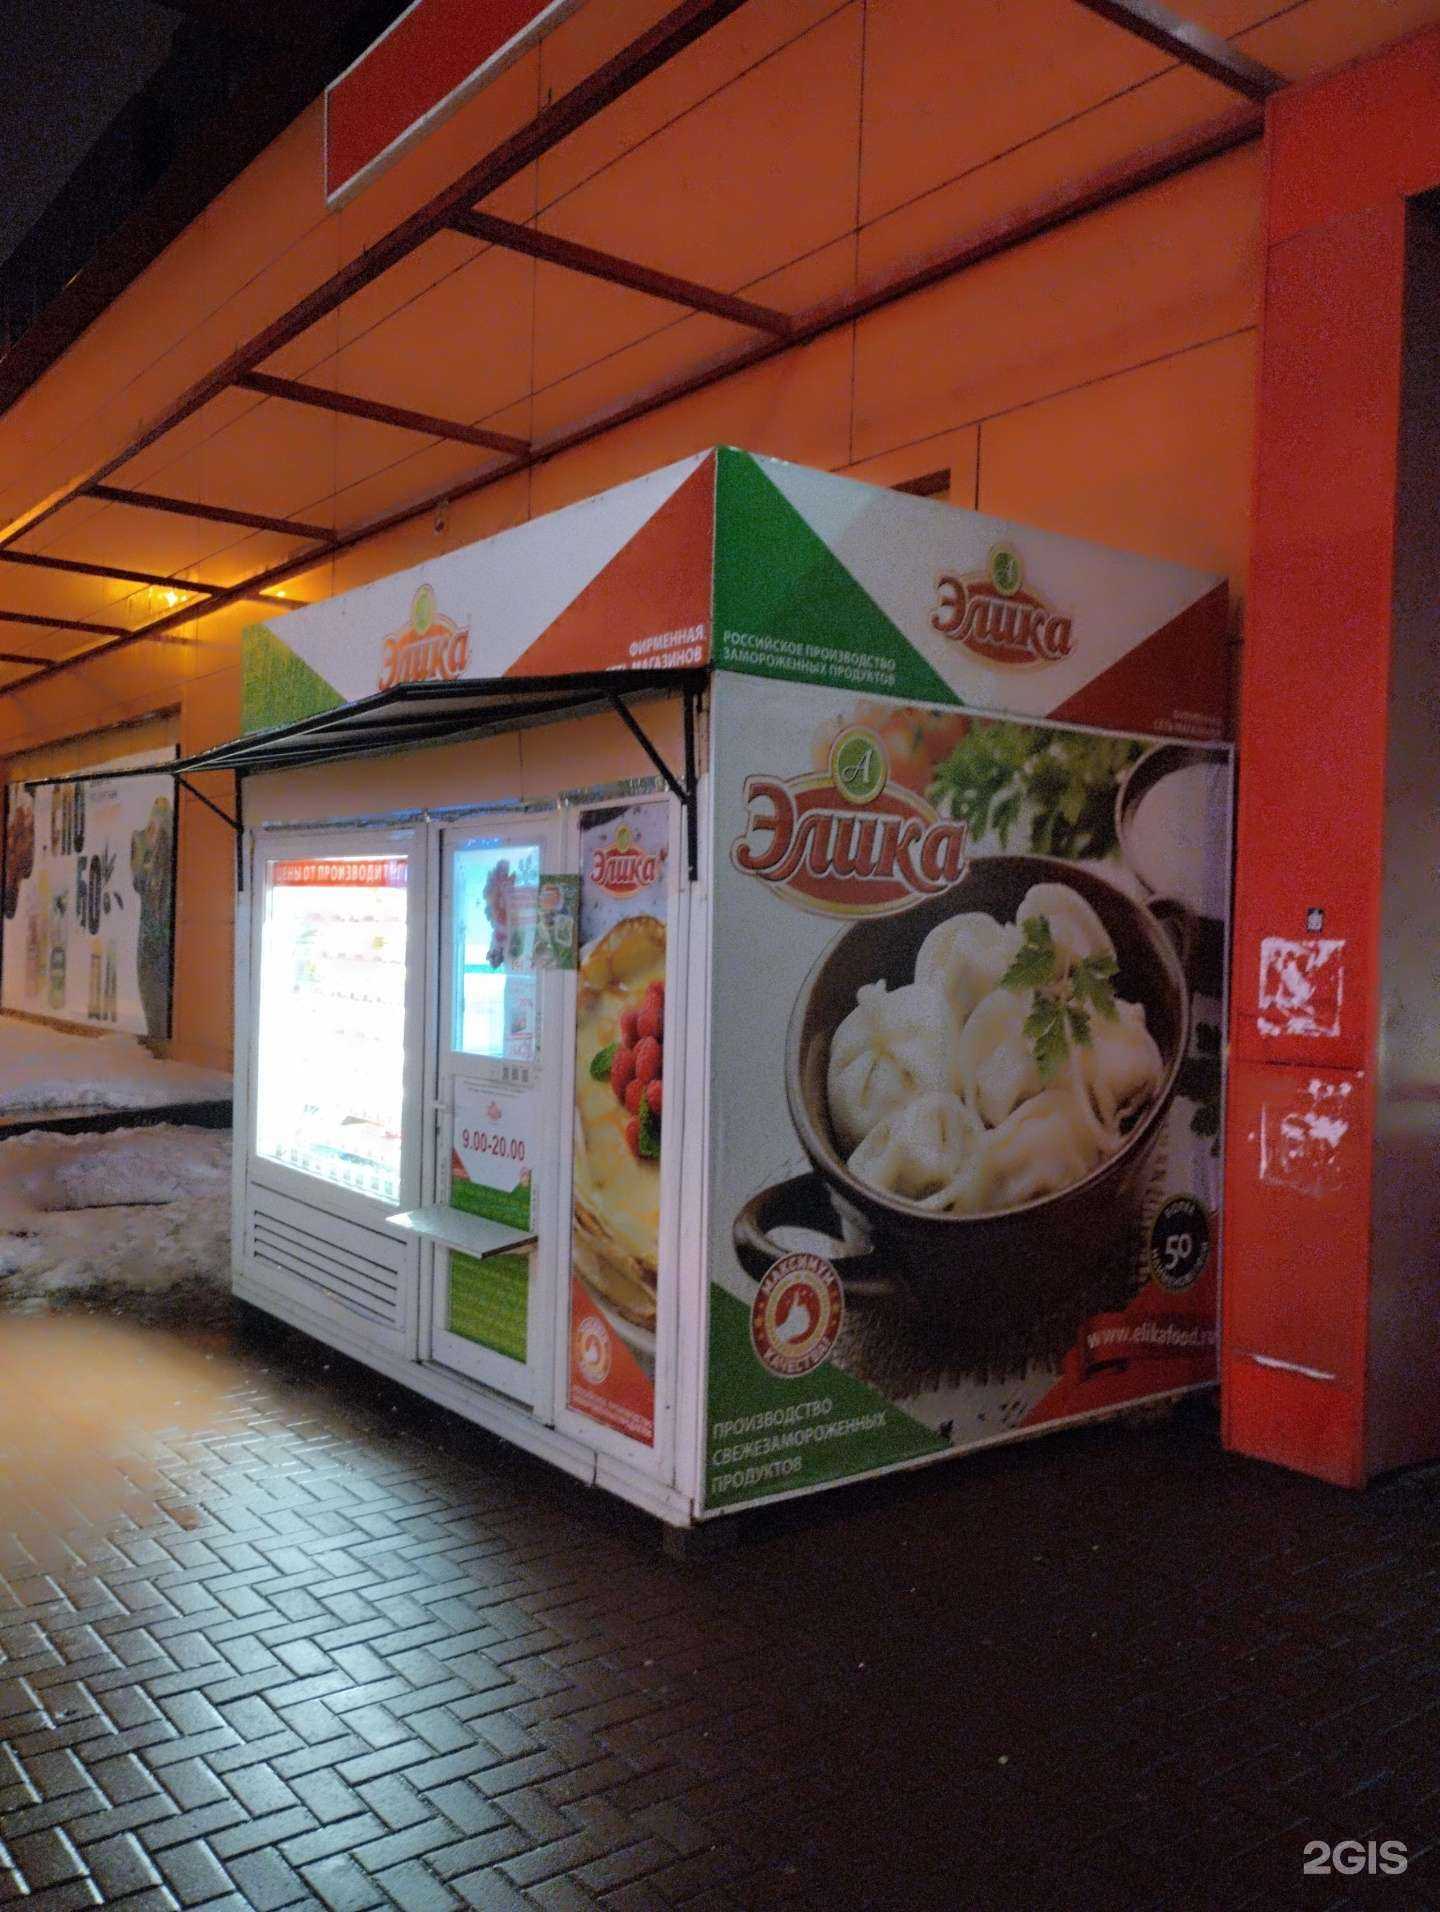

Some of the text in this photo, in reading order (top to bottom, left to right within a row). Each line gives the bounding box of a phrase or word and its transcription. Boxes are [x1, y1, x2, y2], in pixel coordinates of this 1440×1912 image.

[931, 575, 1073, 661] Элика
[378, 628, 470, 691] Элика
[629, 624, 704, 656] ФИРМЕННАЯ
[723, 630, 896, 671] РОССИЙСКОЕ ПРОИЗВОДСТВО
[723, 646, 897, 686] ЗАМОРОЖЕННЫХ ПРОДУКТОВ
[733, 780, 969, 895] Элика
[303, 864, 316, 882] ОТ
[591, 849, 657, 888] Элика
[462, 1128, 526, 1161] 9.00-20.00
[1165, 1232, 1193, 1271] 50
[712, 1410, 888, 1466] СВЕЖЕЗАМОРОЖЕННЫХ
[713, 1397, 834, 1440] ПРОИЗВОДСТВО
[711, 1456, 803, 1495] ПРОДУКТОВ
